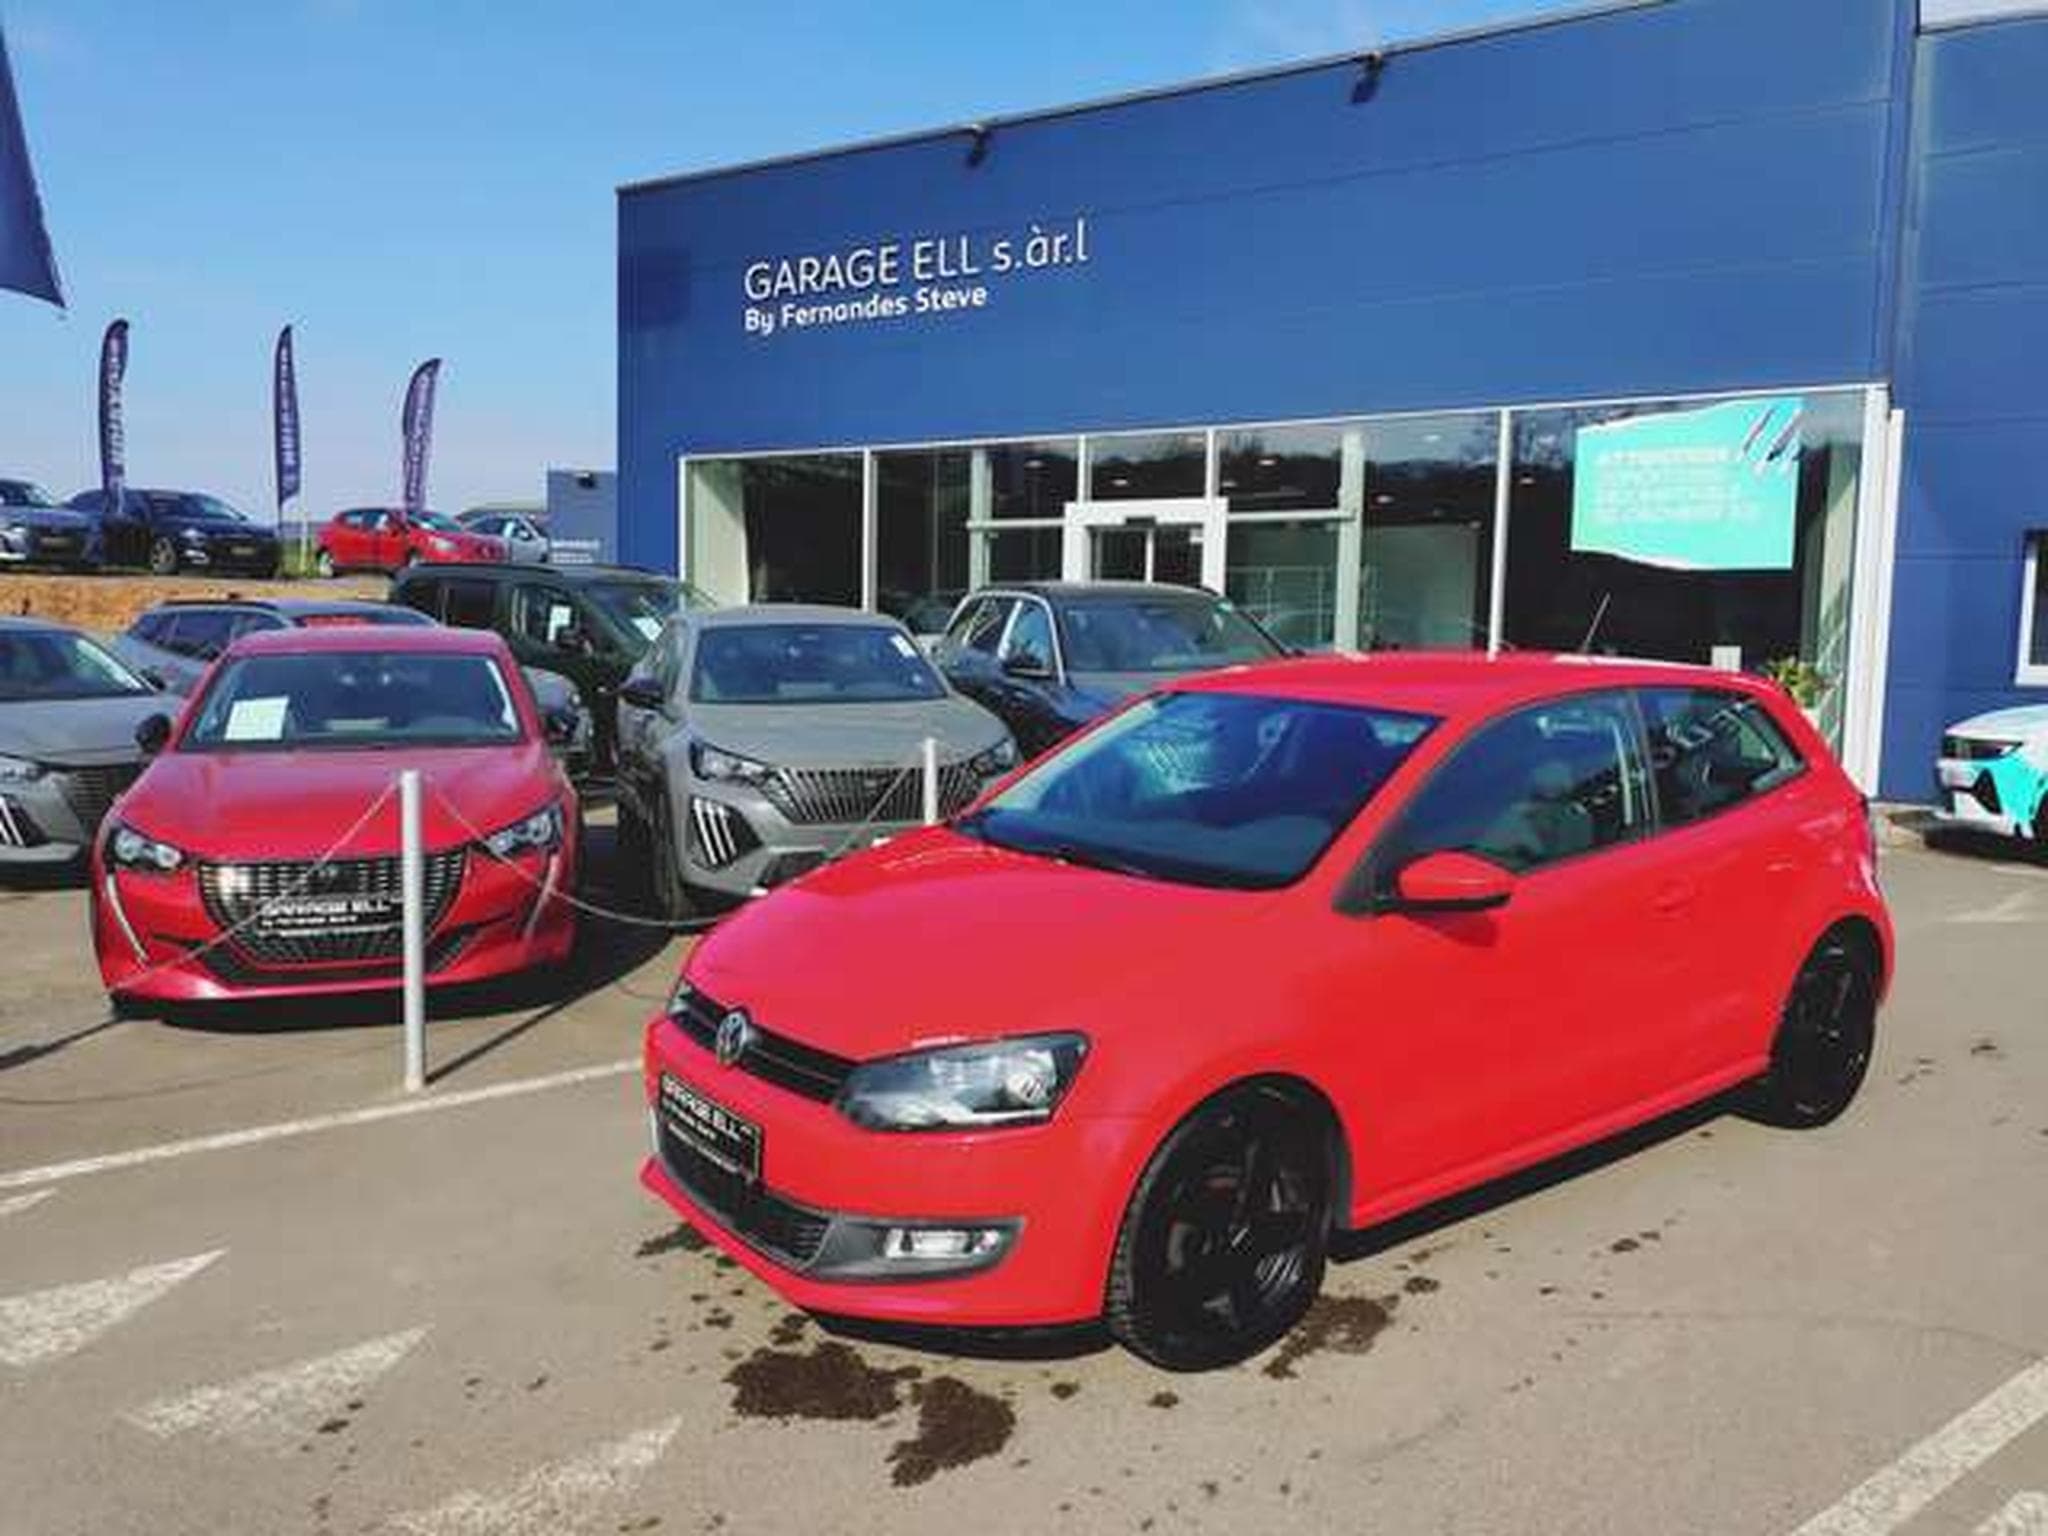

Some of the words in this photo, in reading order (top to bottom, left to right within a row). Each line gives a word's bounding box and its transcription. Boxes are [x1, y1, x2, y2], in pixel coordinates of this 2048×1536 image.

[744, 244, 900, 301] GARAGE
[912, 235, 979, 281] ELL
[744, 307, 775, 336] By
[782, 292, 908, 328] Fernandes
[916, 285, 988, 313] Steve
